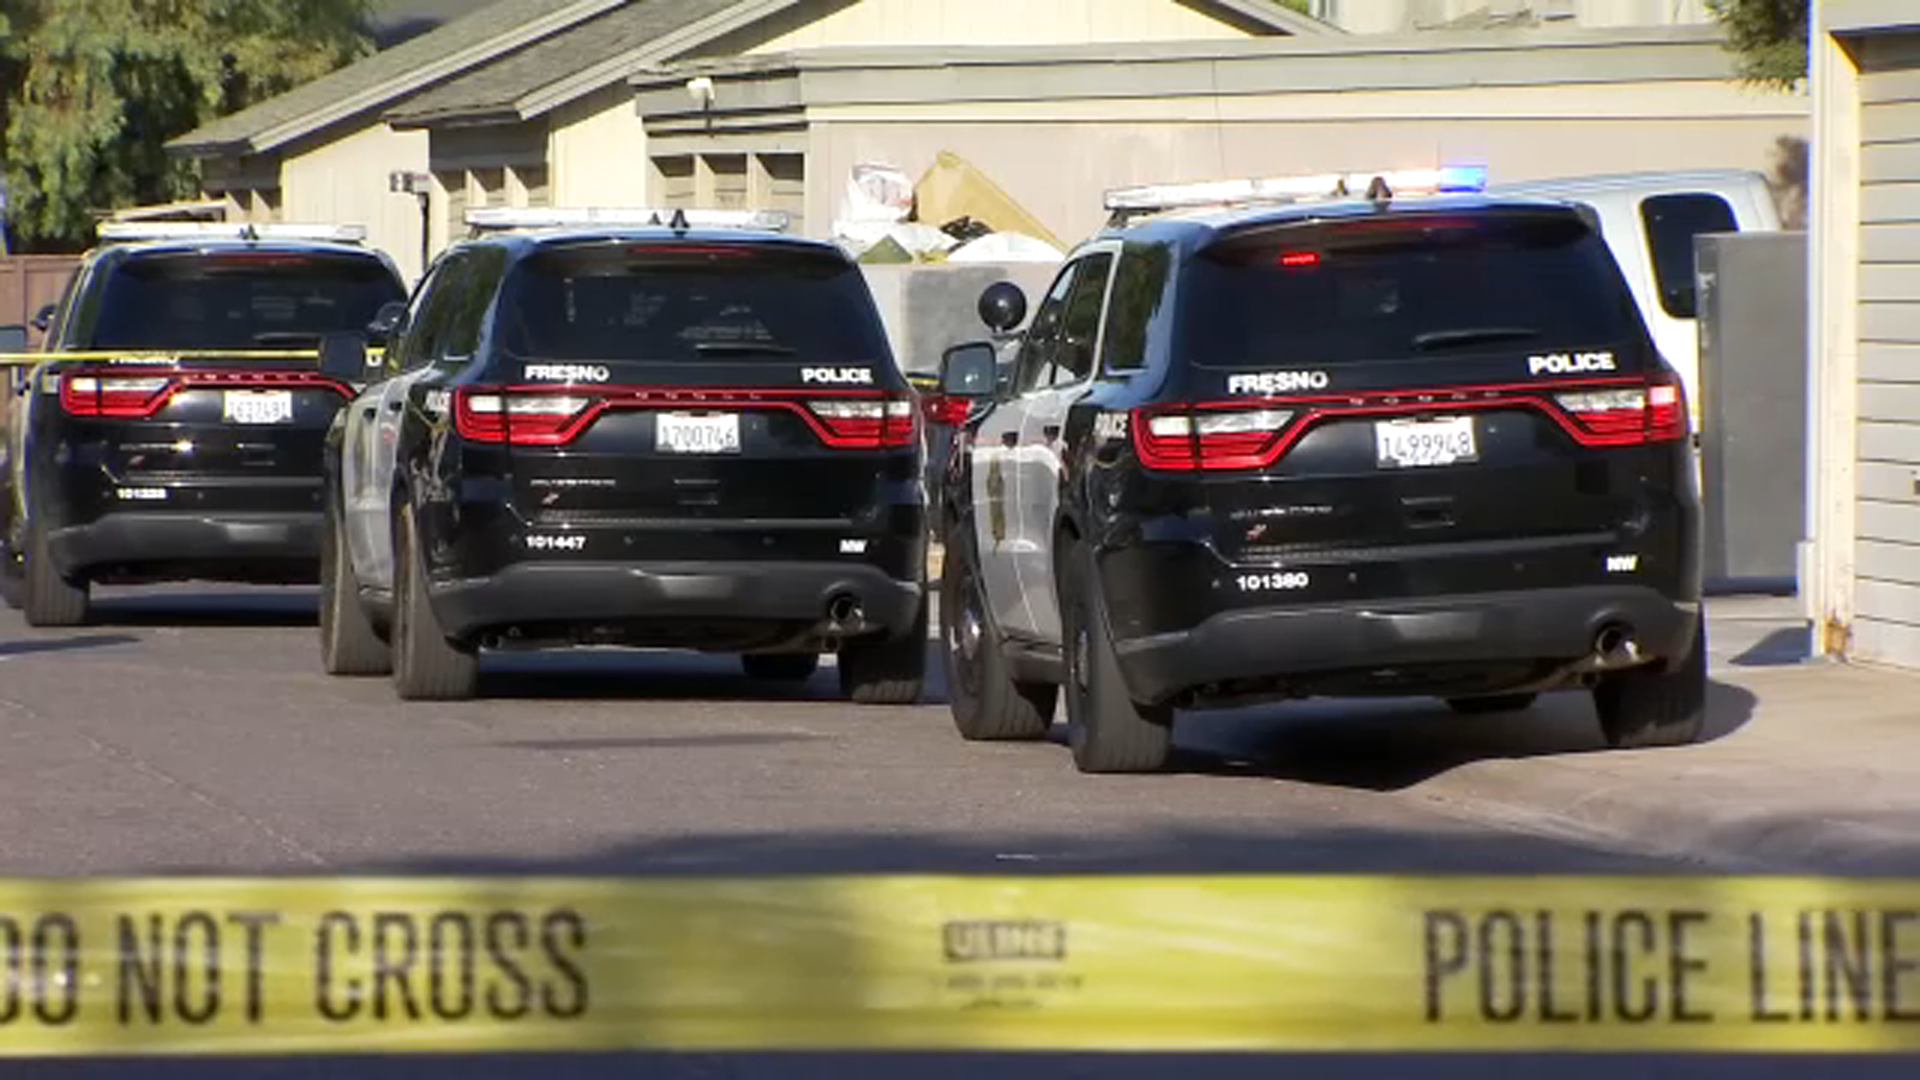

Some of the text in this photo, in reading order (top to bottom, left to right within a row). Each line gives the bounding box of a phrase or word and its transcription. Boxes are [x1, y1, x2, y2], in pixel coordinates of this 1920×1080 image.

[524, 364, 872, 384] FRESNO POLICE
[1227, 352, 1616, 393] FRESNO POLICE
[662, 425, 736, 447] 1700746
[1382, 430, 1471, 460] 1499948
[525, 535, 586, 550] 101447
[1607, 555, 1638, 571] NW
[1236, 571, 1309, 591] 101380
[116, 911, 280, 1025] NOT
[315, 909, 589, 1022] CROSS
[1423, 910, 1920, 1023] POLICE LINE
